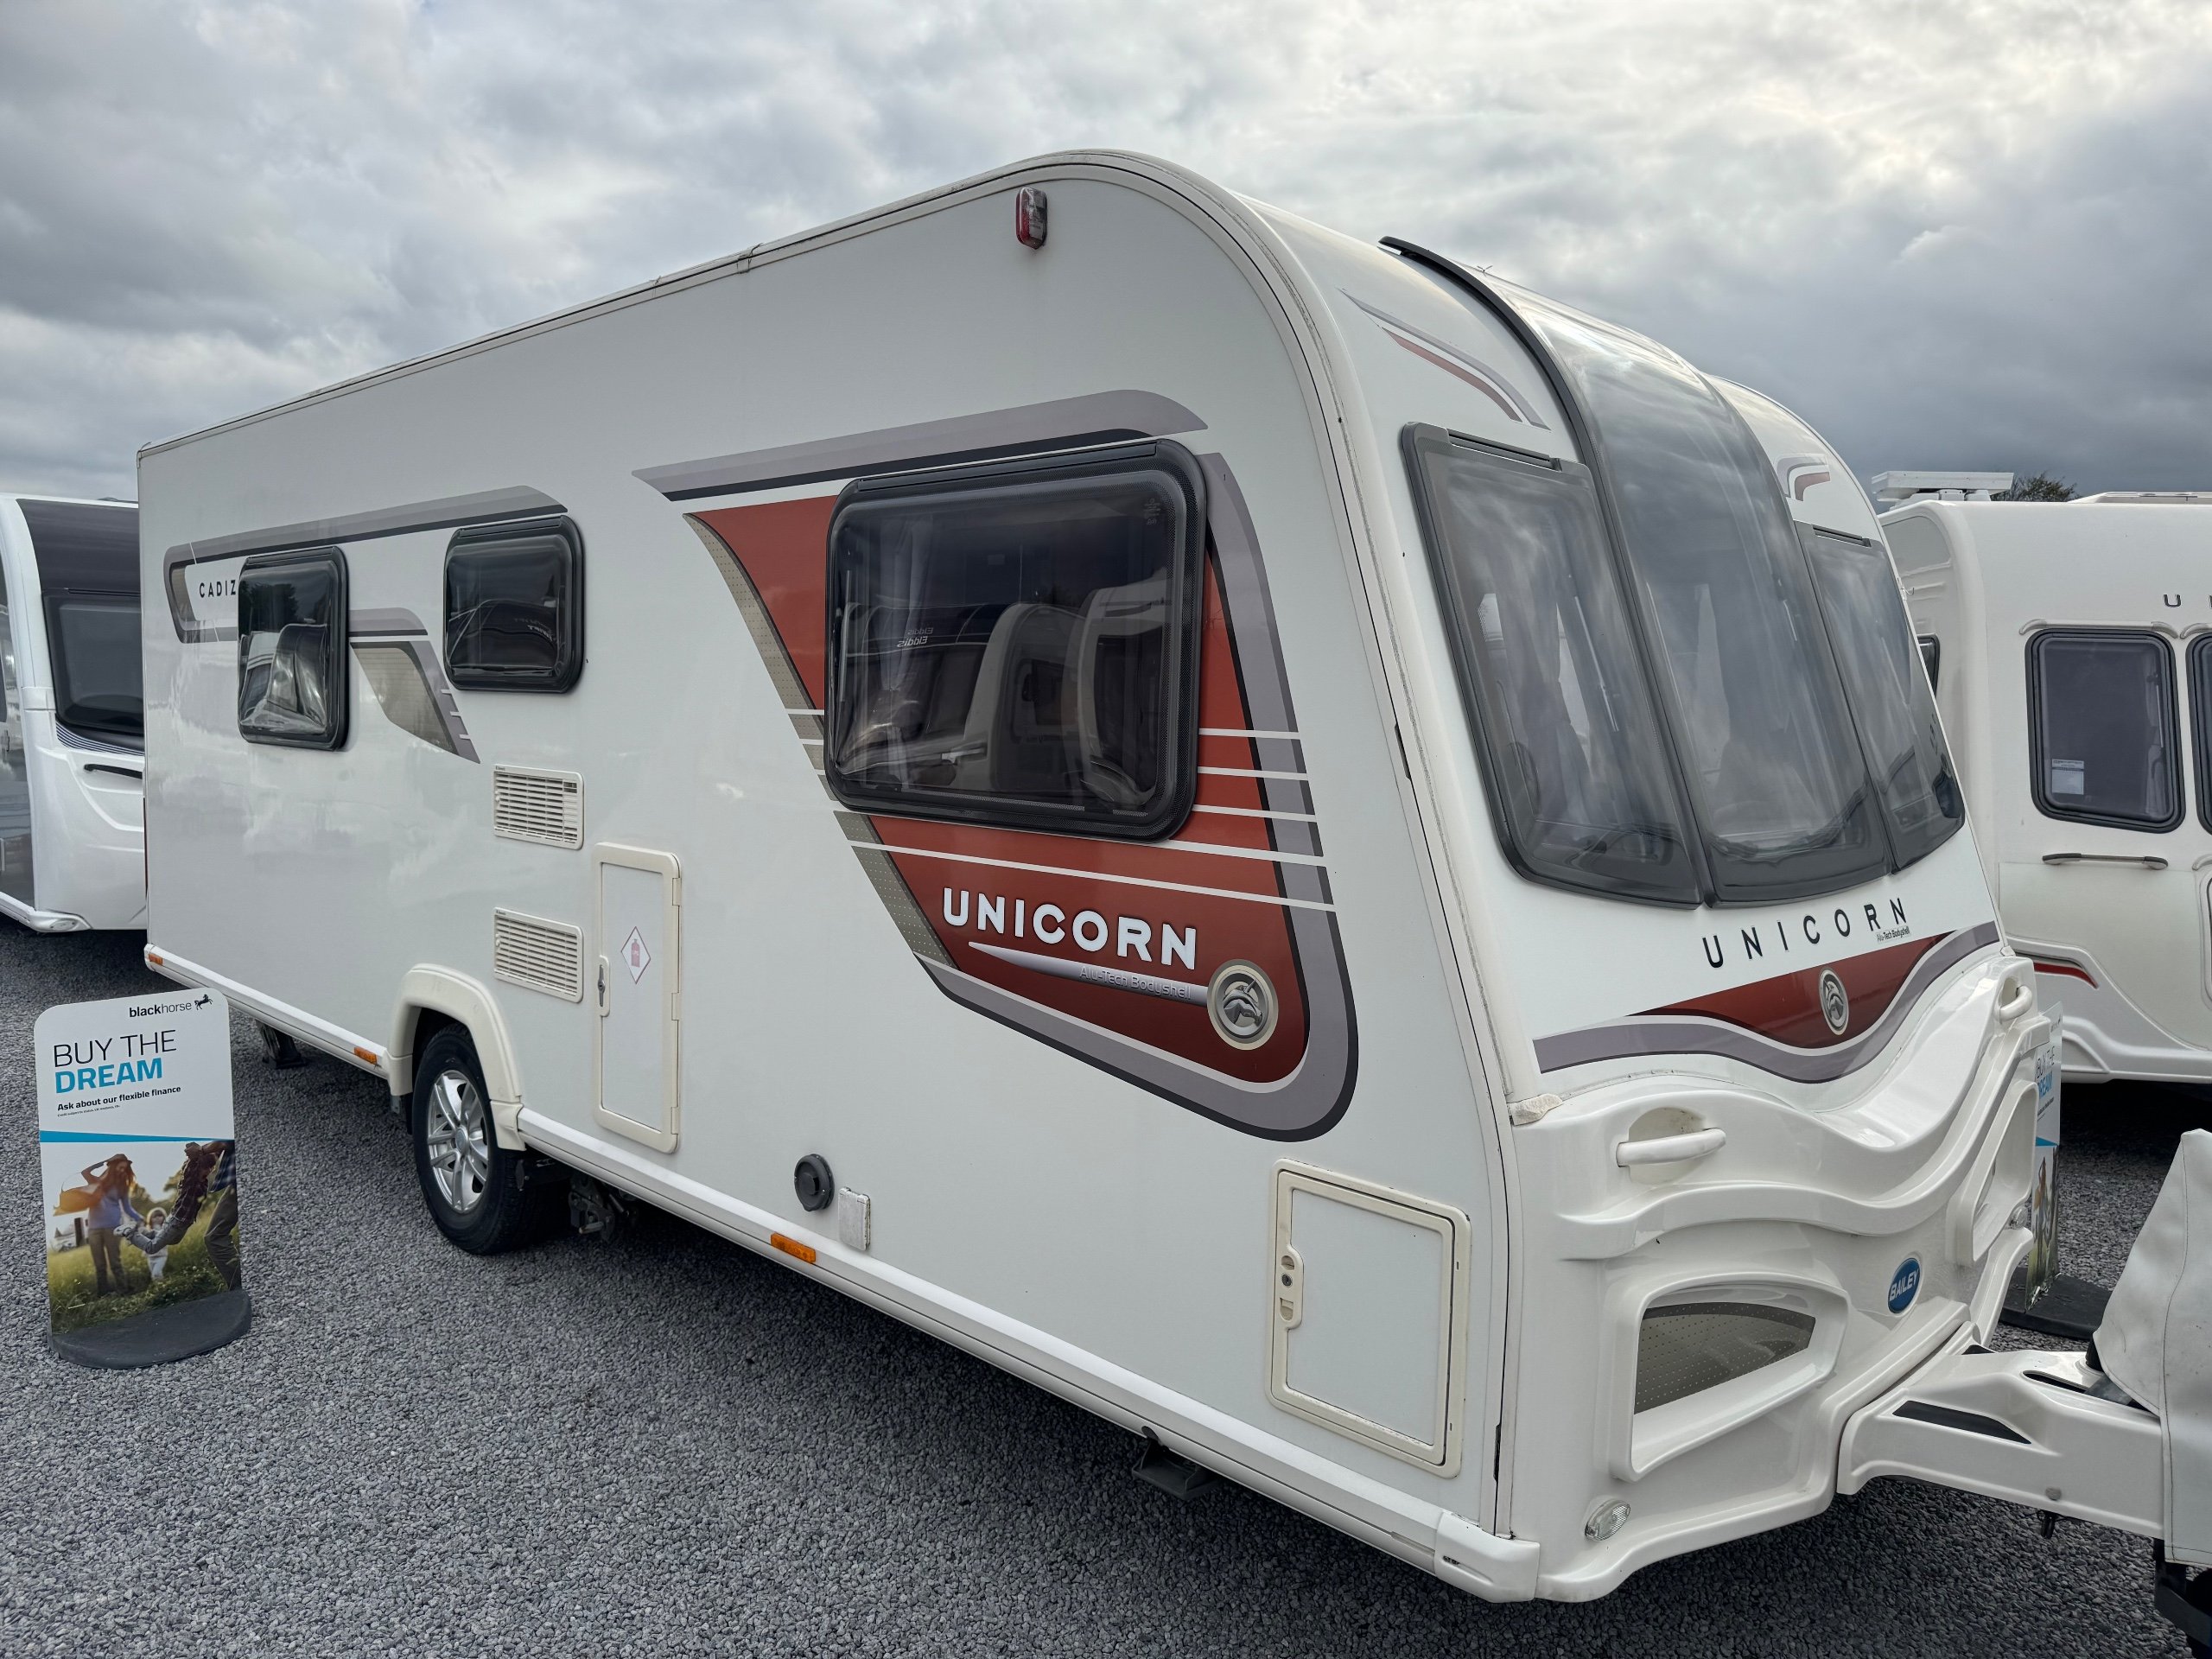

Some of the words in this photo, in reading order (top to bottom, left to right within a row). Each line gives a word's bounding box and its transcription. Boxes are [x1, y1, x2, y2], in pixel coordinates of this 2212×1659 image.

[199, 579, 237, 598] CADIZ
[944, 887, 1197, 970] UNICORN
[1702, 898, 1907, 969] UNICORN
[1079, 966, 1128, 987] Alu-Tech
[1130, 976, 1192, 1000] Bodyshell
[129, 1002, 192, 1018] blackhorse
[54, 1038, 113, 1068] BUY
[120, 1029, 177, 1058] THE
[54, 1058, 163, 1094] DREAM
[57, 1103, 74, 1111] Ask
[75, 1097, 101, 1109] about
[103, 1096, 118, 1104] our
[119, 1090, 150, 1102] flexible
[151, 1086, 181, 1096] finance
[1889, 1268, 1919, 1302] BAILEY
